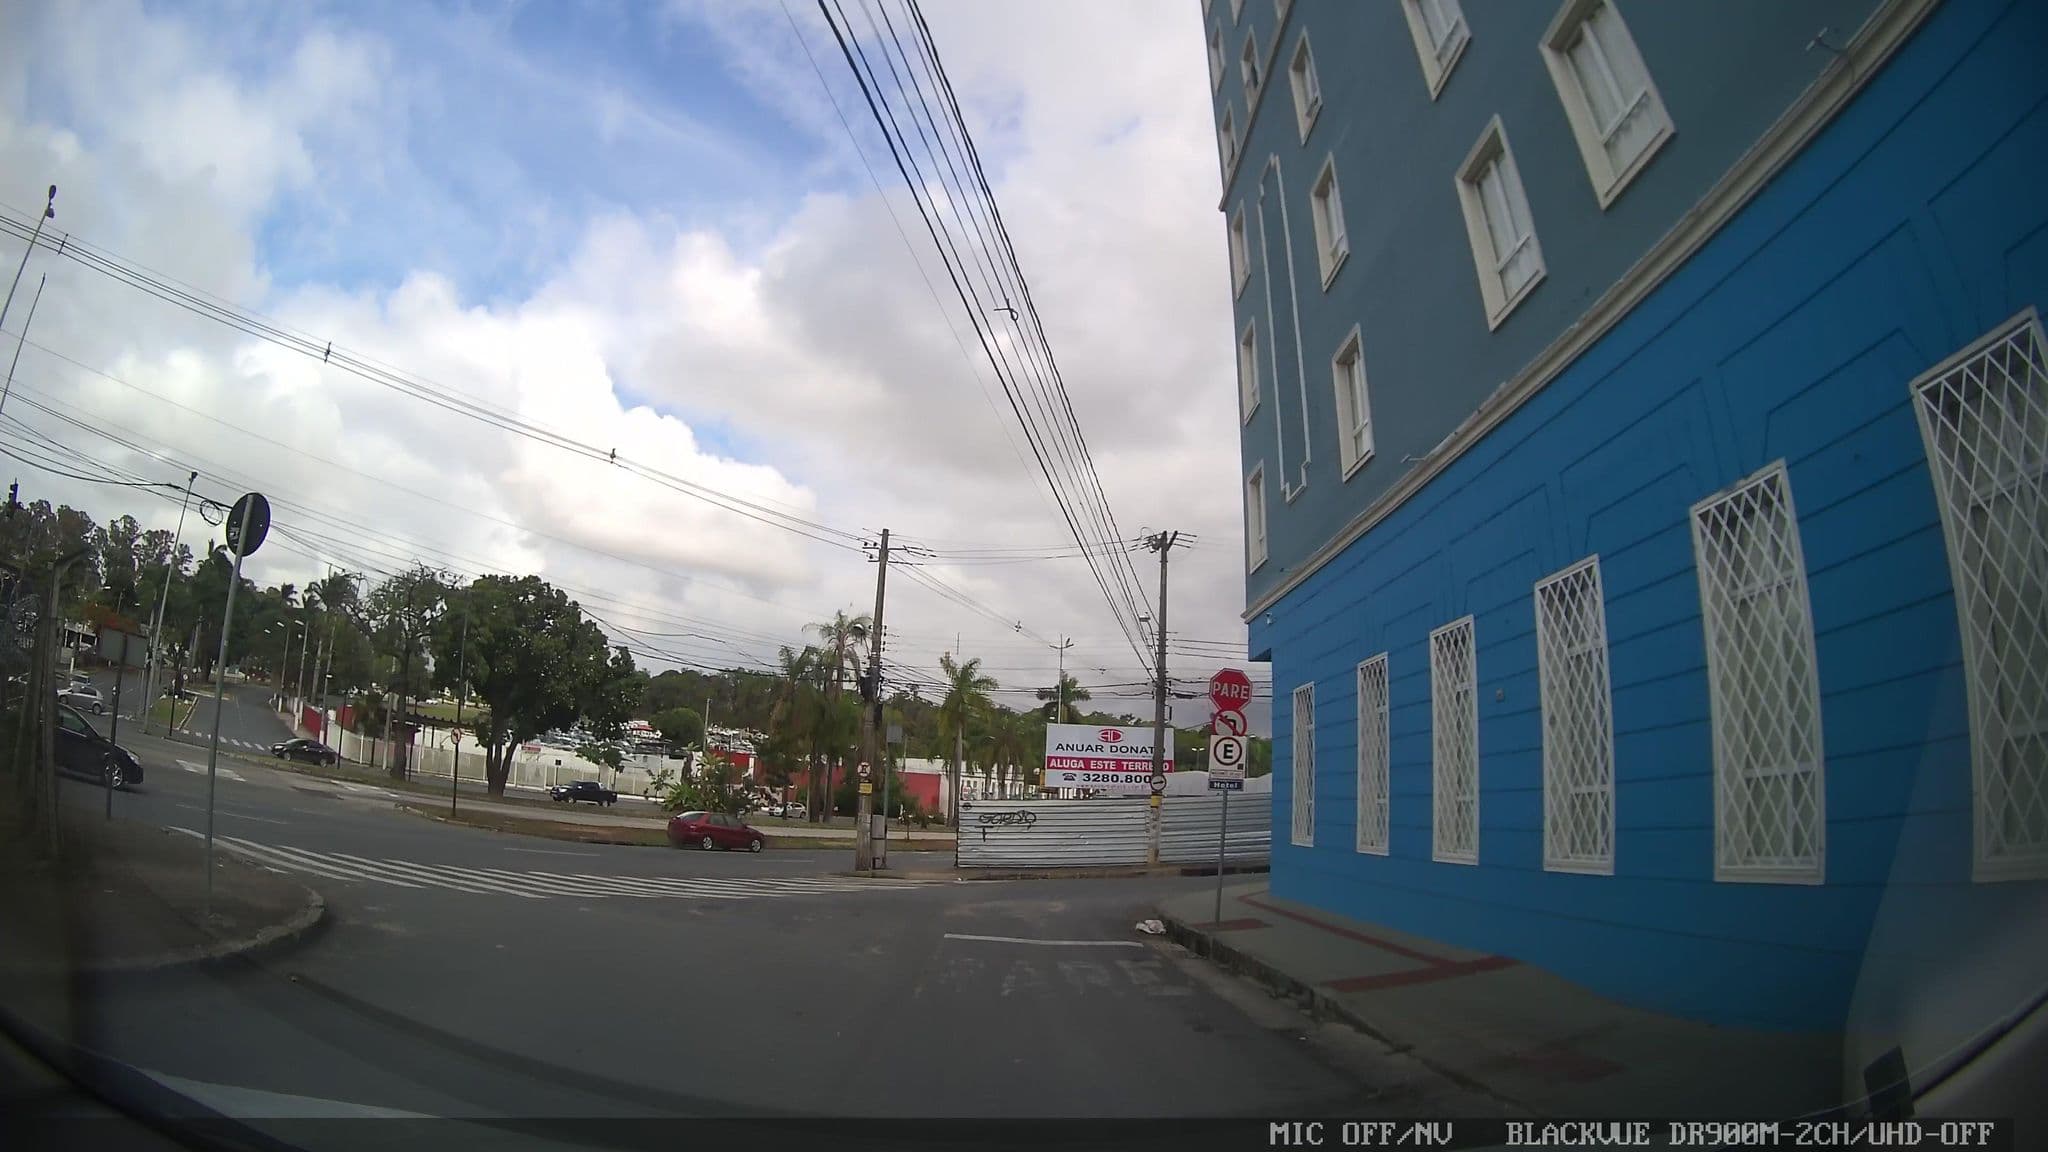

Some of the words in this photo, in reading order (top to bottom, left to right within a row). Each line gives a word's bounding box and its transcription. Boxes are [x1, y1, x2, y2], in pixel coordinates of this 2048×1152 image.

[1212, 682, 1249, 699] PARE
[1055, 743, 1104, 753] ANUAR
[1109, 745, 1165, 754] DONAT
[1223, 743, 1234, 760] E
[1050, 759, 1085, 769] ALUGA
[1090, 760, 1117, 770] ESTE
[1121, 761, 1169, 771] TERREO
[1083, 773, 1152, 784] 3280.800
[1213, 781, 1238, 789] Hotel
